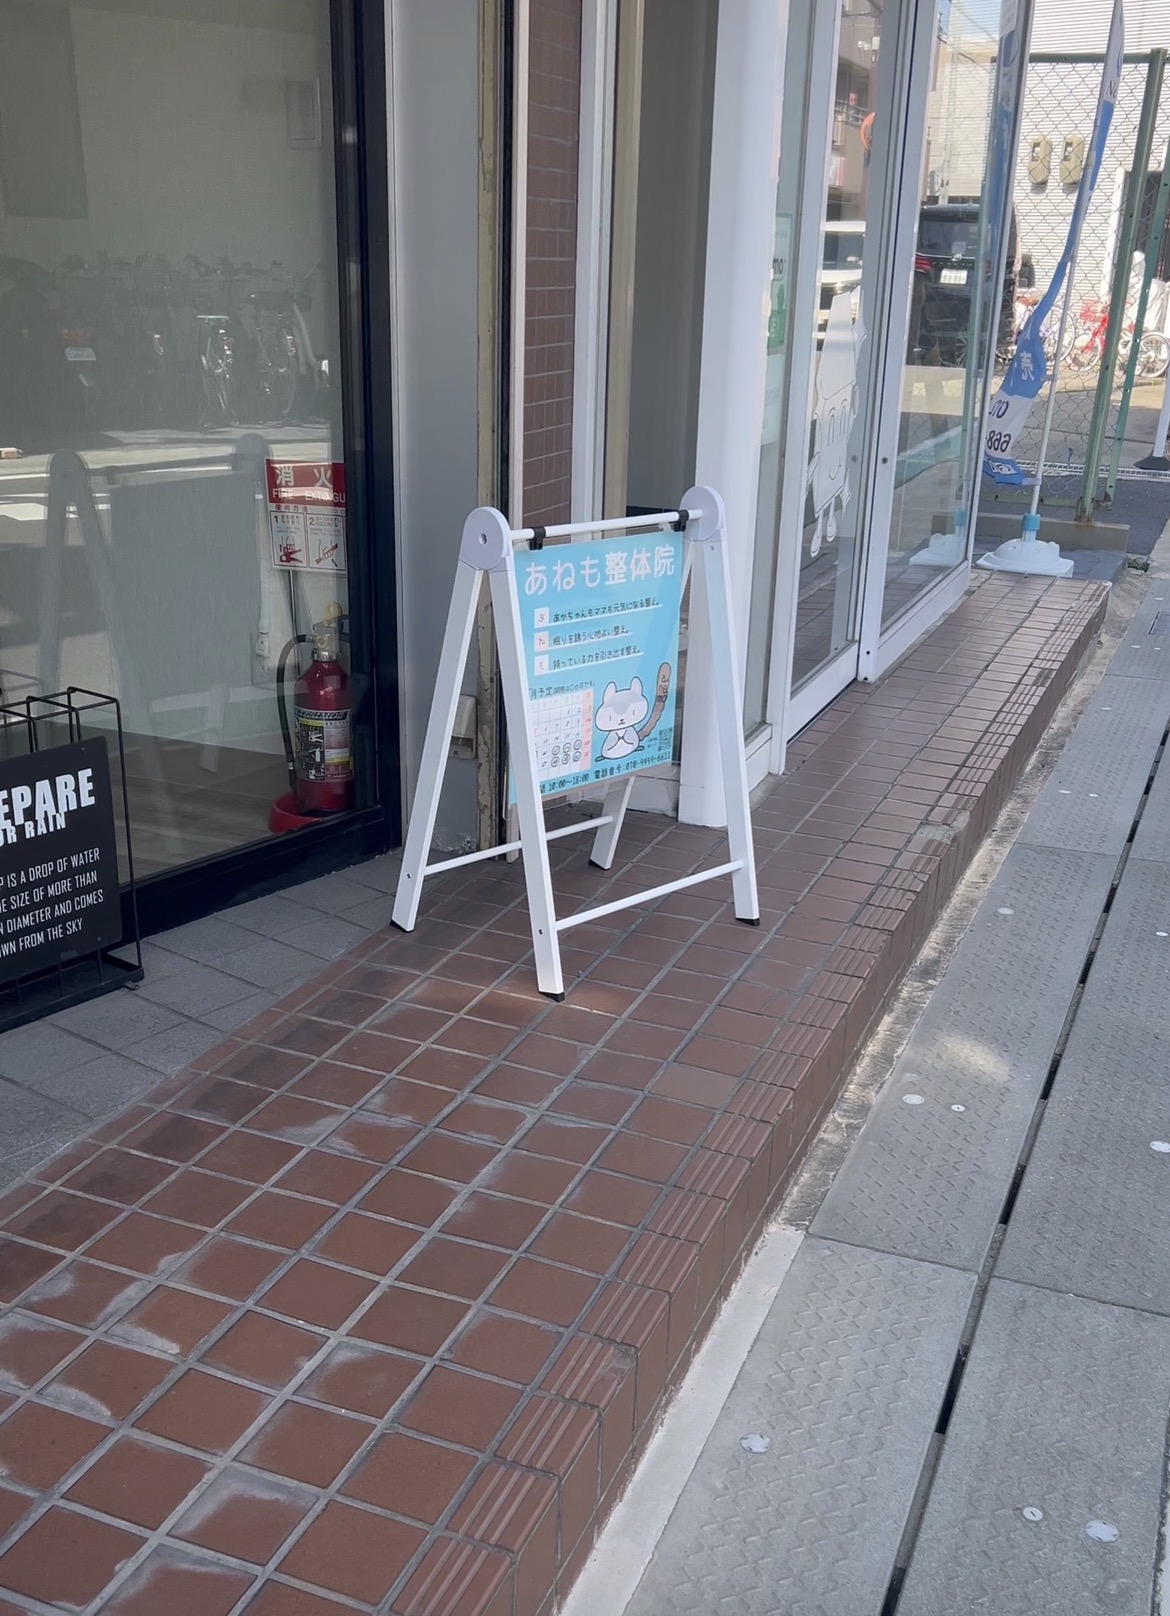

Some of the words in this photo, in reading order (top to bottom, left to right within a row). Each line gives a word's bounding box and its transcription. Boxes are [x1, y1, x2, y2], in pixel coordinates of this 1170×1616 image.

[525, 543, 675, 596] あねも整体院
[24, 812, 67, 839] RAIN
[7, 872, 17, 888] IS
[20, 870, 27, 884] A
[28, 861, 54, 882] DROP
[57, 857, 69, 873] OF
[70, 847, 100, 869] WATER
[10, 891, 31, 910] SIZE
[33, 887, 45, 903] OF
[48, 879, 73, 898] MORE
[74, 870, 98, 890] THAN
[6, 907, 51, 933] DIAMETER
[54, 900, 73, 917] AND
[74, 889, 104, 911] COMES
[19, 930, 45, 951] FROM
[47, 924, 64, 942] THE
[66, 918, 83, 935] SKY
